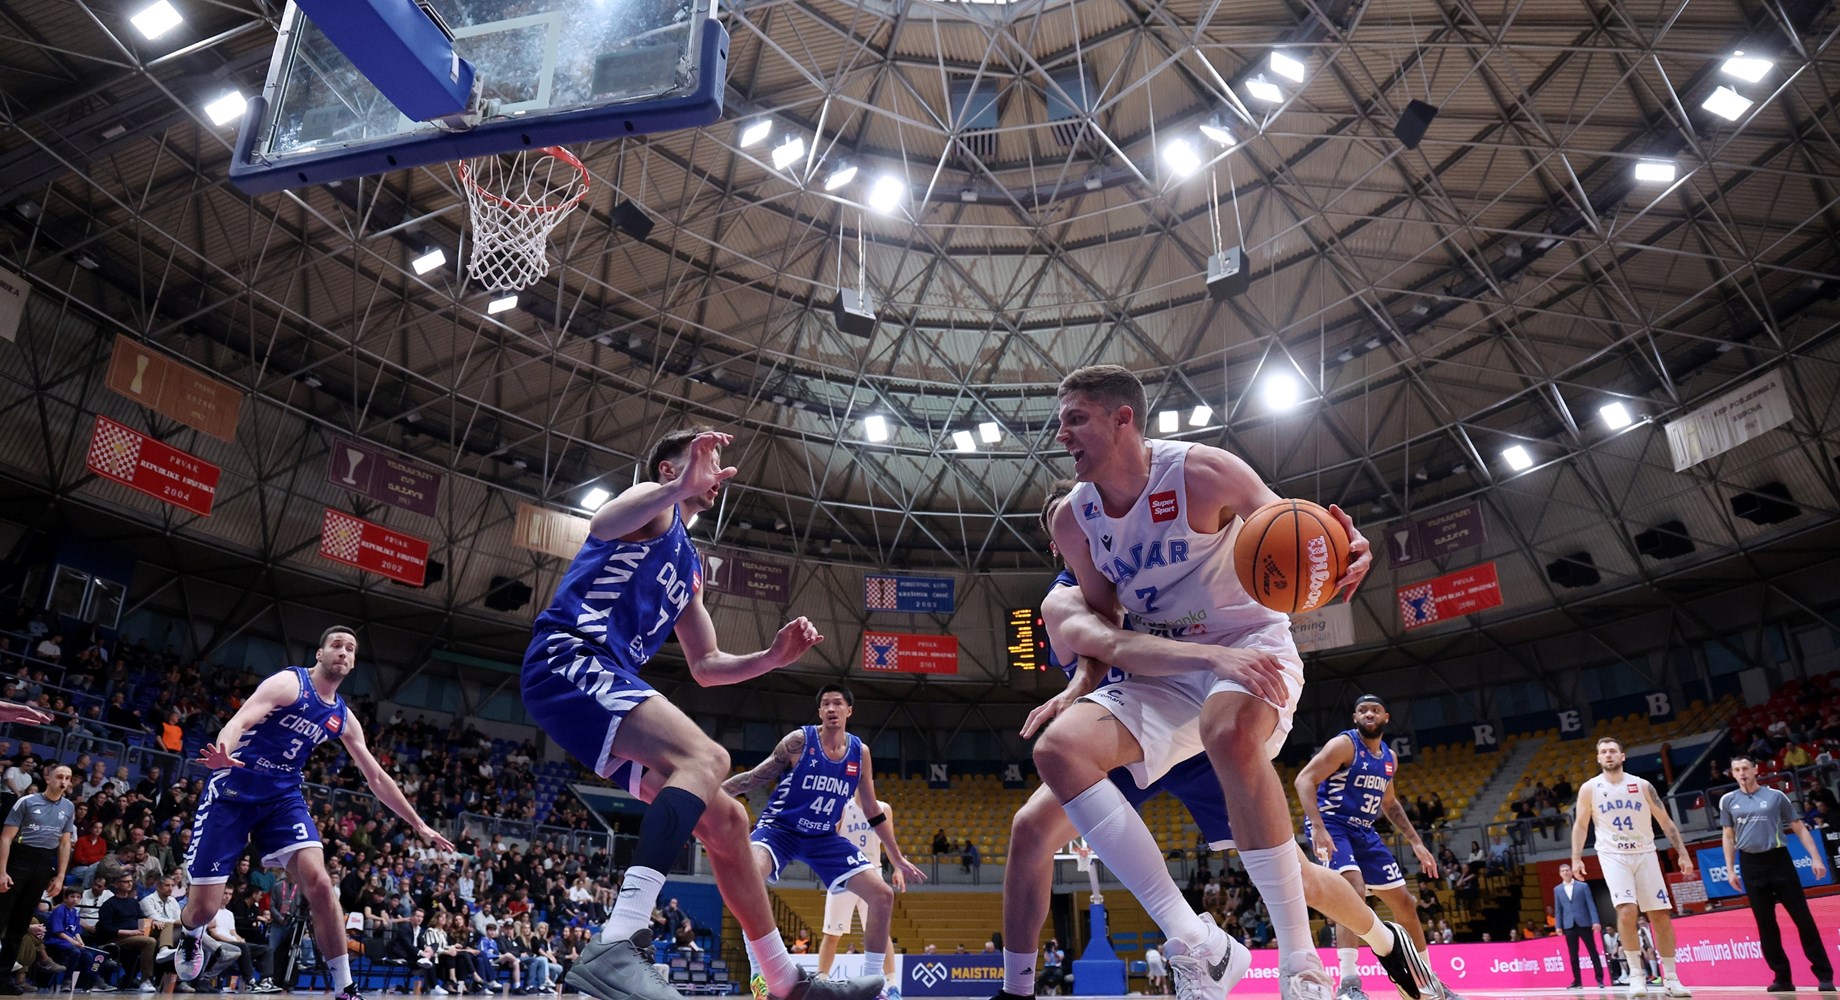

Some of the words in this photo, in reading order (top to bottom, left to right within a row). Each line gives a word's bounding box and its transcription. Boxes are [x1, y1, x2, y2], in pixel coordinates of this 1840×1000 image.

[140, 459, 180, 481] REPUBLIKE
[170, 456, 199, 473] PRVAK
[163, 485, 190, 501] 2004
[1152, 498, 1175, 508] Super
[1154, 505, 1175, 515] Sport
[360, 540, 394, 557] REPUBLIKE
[385, 535, 408, 548] PRVAK
[381, 560, 403, 573] 2002
[1301, 535, 1330, 610] Wilson
[647, 605, 669, 636] 7
[282, 738, 304, 760] 3
[801, 774, 850, 798] CIBONA
[809, 796, 836, 816] 44
[1360, 793, 1381, 815] 32
[1599, 800, 1642, 814] ZADAR
[292, 822, 309, 840] 3
[798, 817, 823, 831] ERSTE
[1612, 816, 1634, 831] 44
[859, 834, 867, 847] 9
[846, 850, 869, 866] 44
[1382, 862, 1403, 881] 32
[1709, 864, 1740, 882] ERSE
[951, 967, 1004, 979] MAISTRA
